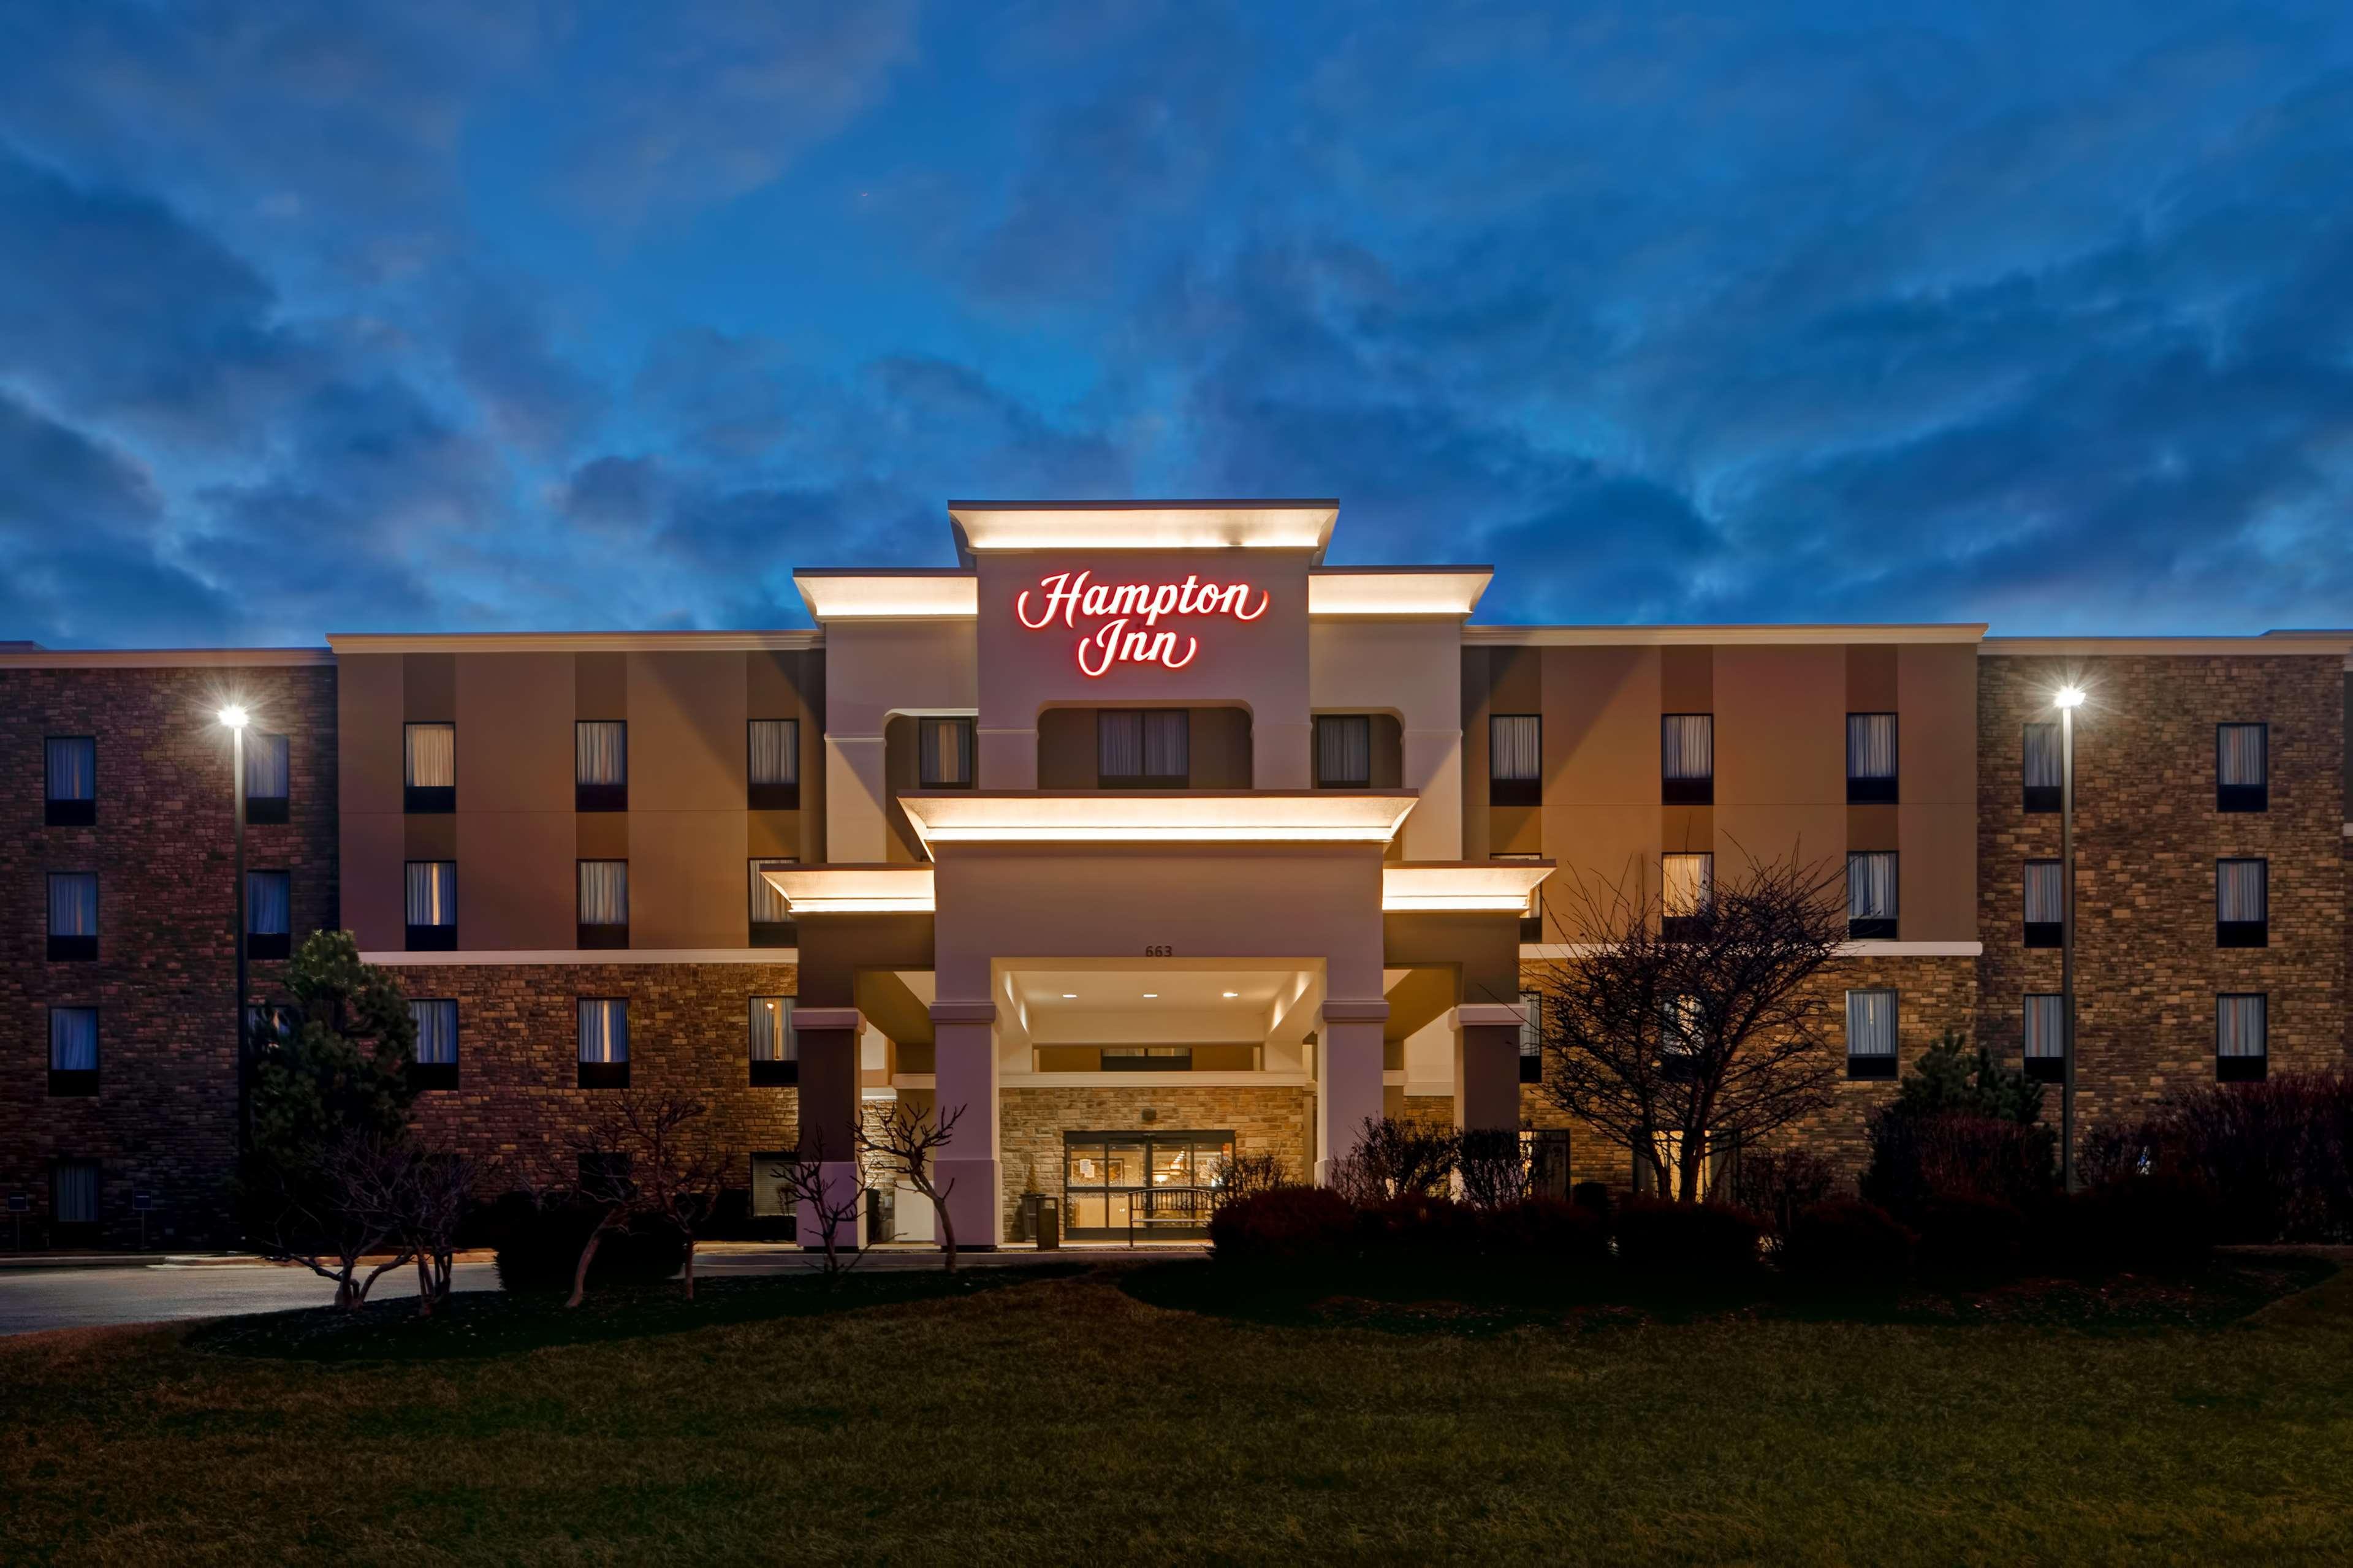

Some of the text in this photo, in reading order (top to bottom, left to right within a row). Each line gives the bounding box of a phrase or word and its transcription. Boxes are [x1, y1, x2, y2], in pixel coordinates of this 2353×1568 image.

[1017, 570, 1269, 629] Hampton
[1078, 618, 1196, 676] Inn
[1146, 945, 1172, 957] 663
